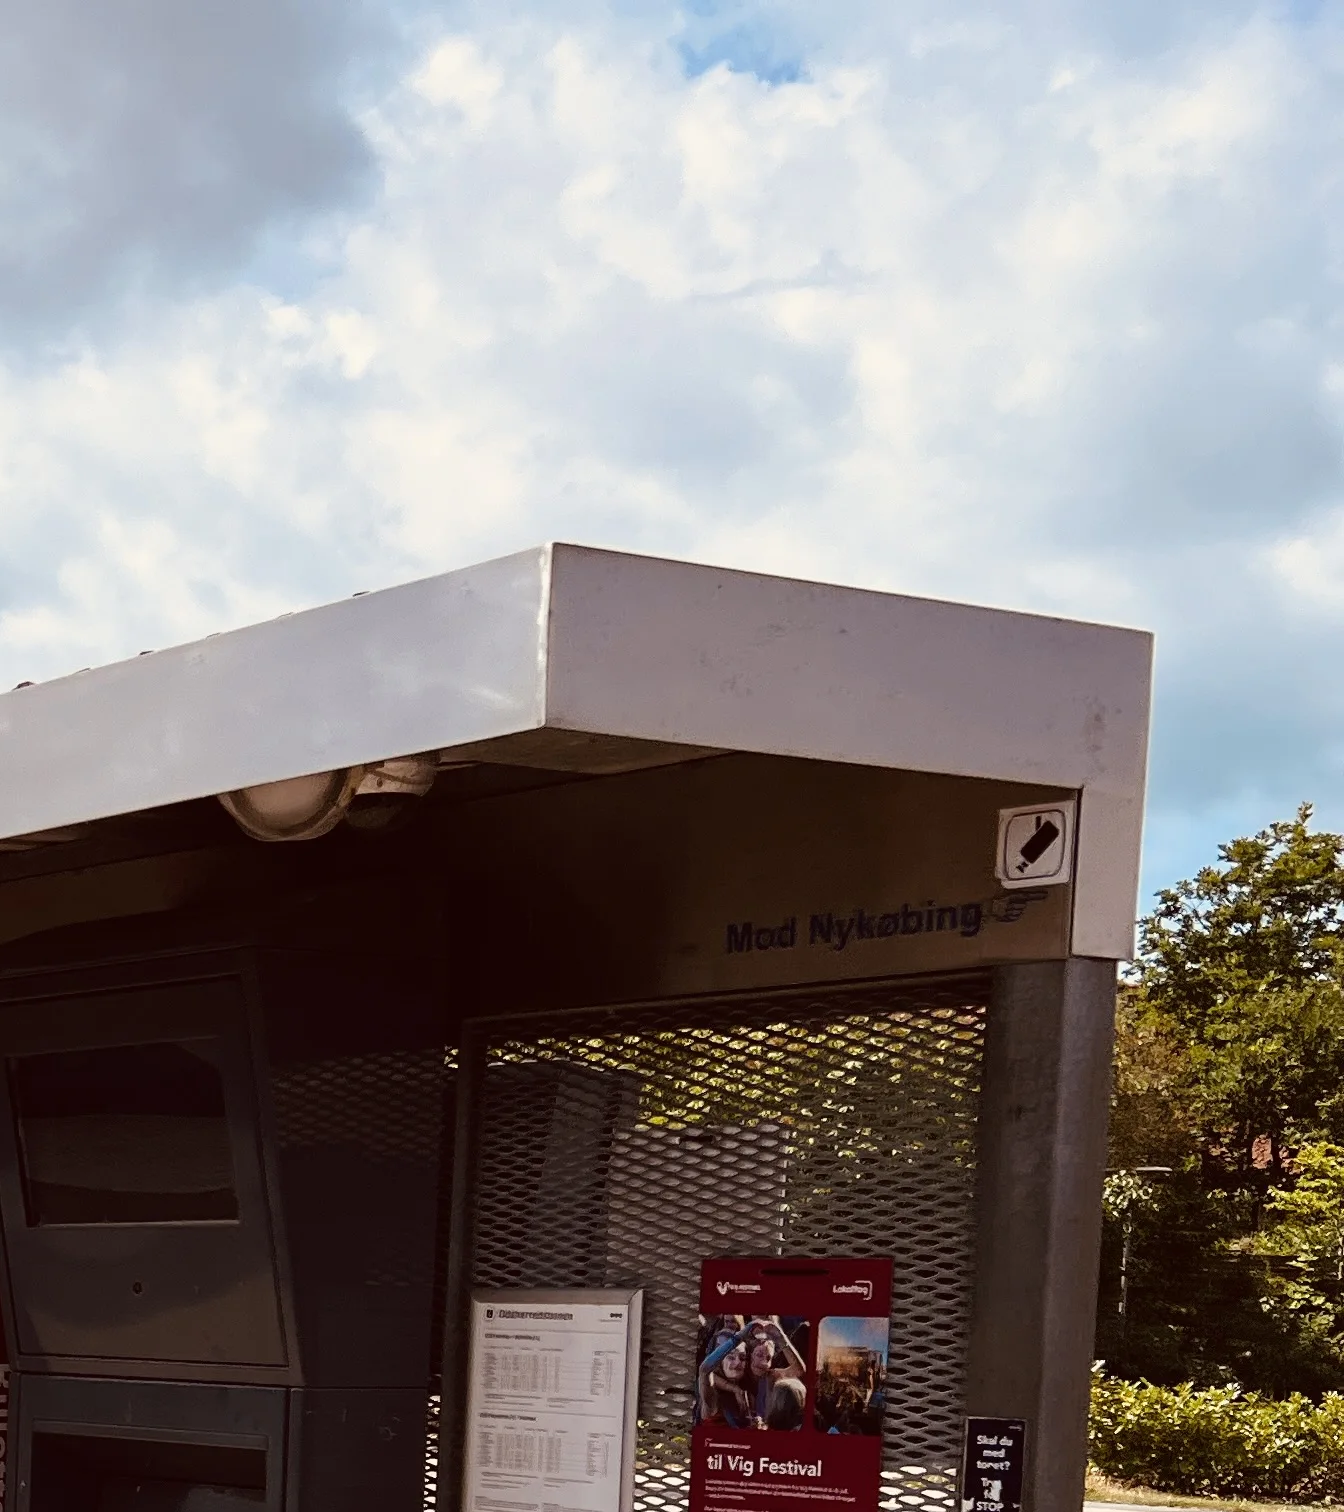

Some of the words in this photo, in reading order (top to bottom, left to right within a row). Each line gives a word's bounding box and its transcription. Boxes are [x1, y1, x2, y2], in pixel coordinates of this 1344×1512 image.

[725, 917, 796, 953] Mod
[809, 900, 983, 951] Nykøbing
[707, 1454, 723, 1470] til
[727, 1455, 754, 1476] Vig
[759, 1457, 822, 1477] Festival
[976, 1501, 1004, 1512] STOP
